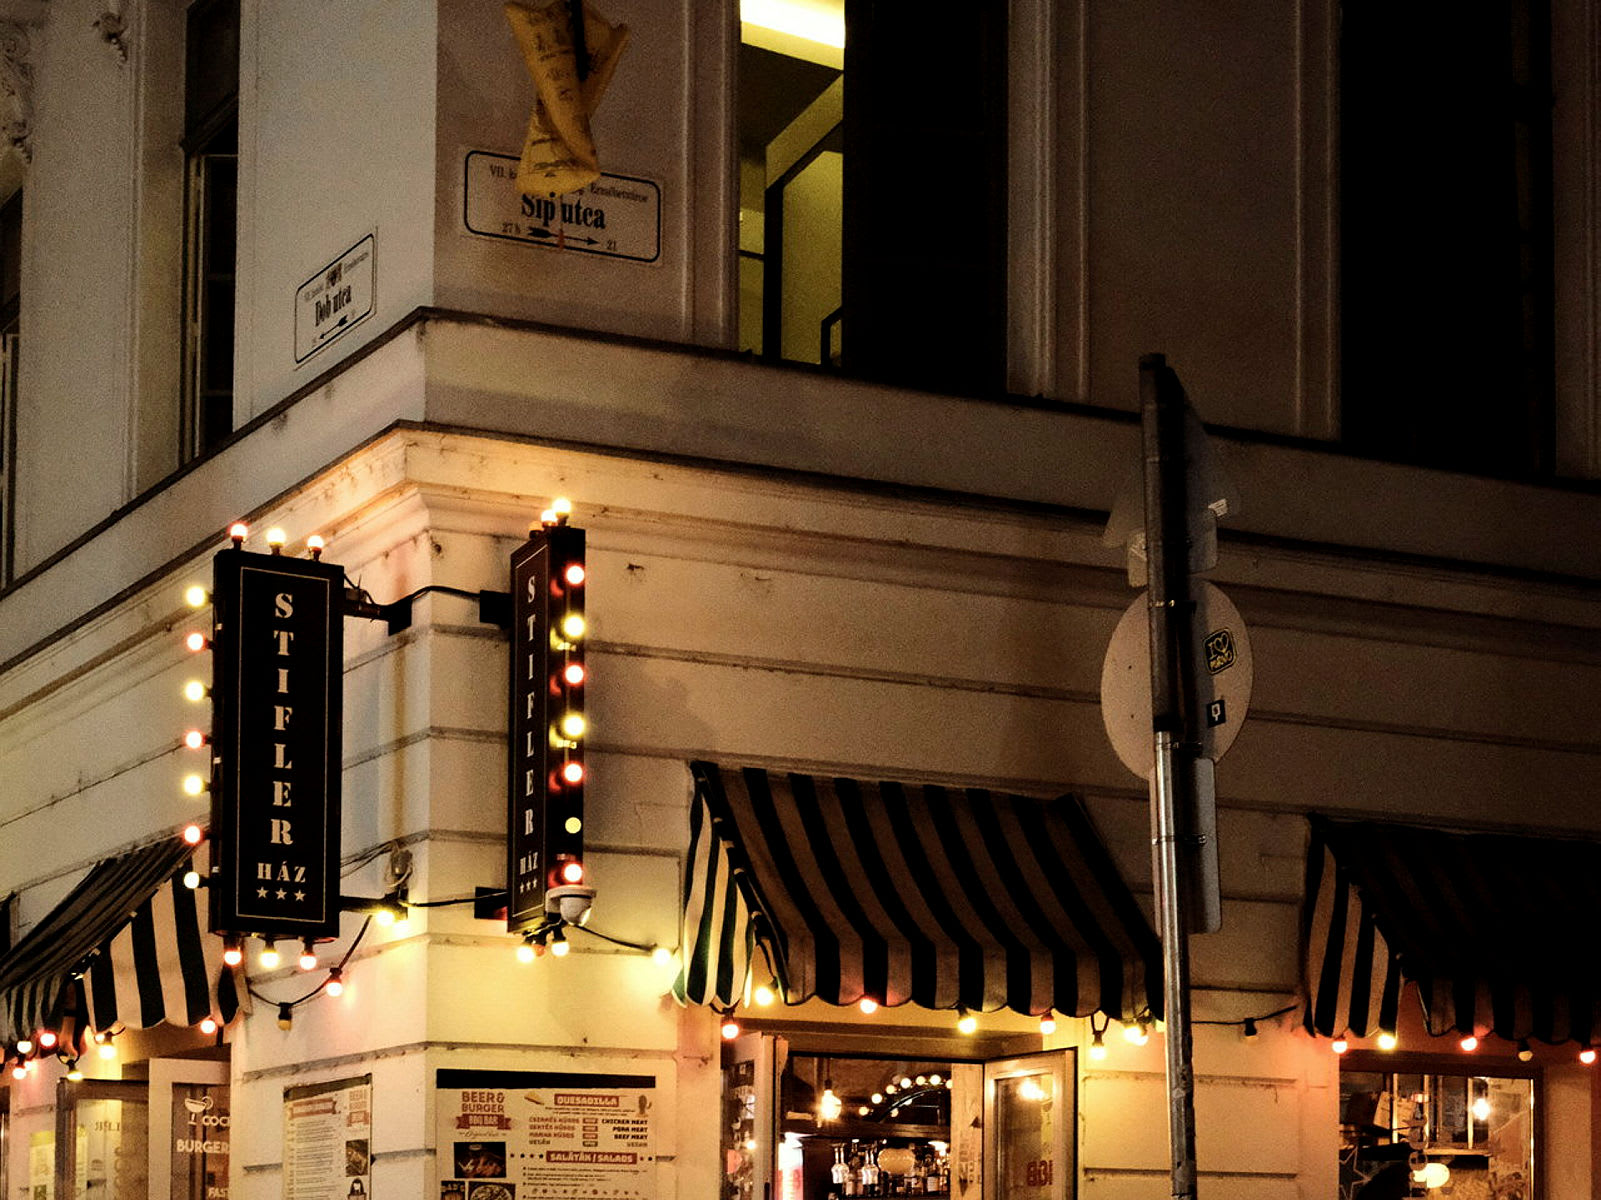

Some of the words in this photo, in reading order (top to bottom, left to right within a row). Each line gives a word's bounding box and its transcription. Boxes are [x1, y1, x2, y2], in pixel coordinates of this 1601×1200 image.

[562, 200, 606, 229] utca
[315, 294, 332, 327] Dob
[333, 285, 352, 313] utca
[269, 592, 294, 846] STIFLER
[523, 575, 536, 837] STIFLER
[256, 858, 307, 884] HÁZ
[518, 851, 540, 876] HÁZ
[462, 1091, 495, 1103] BEER
[462, 1103, 504, 1113] BURGER
